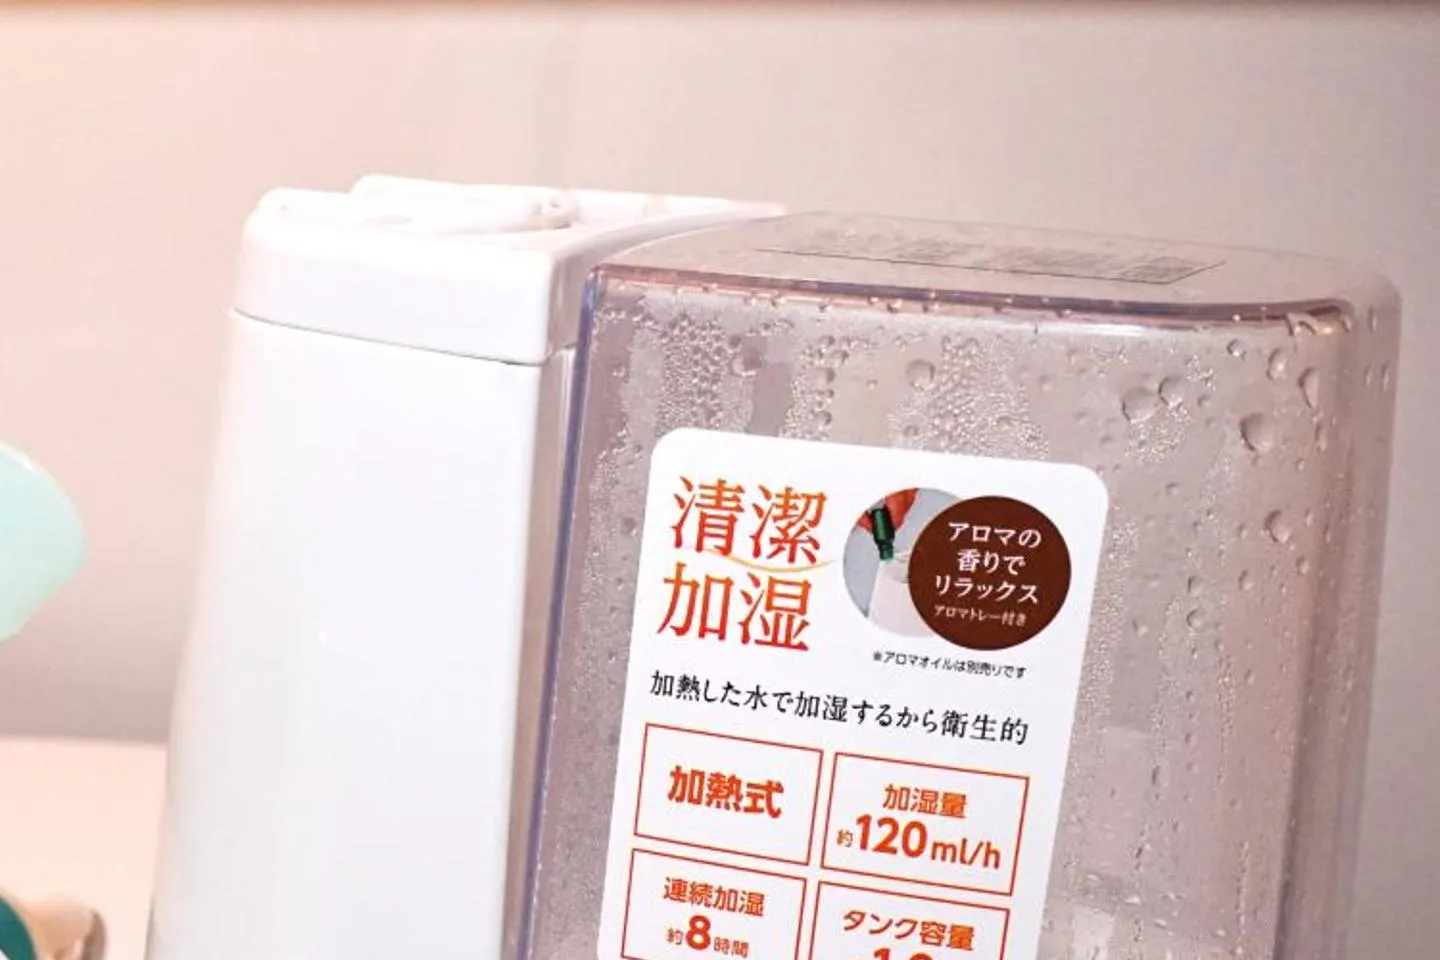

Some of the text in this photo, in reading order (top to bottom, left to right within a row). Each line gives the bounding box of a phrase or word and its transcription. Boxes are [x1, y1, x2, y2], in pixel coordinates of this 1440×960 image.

[671, 475, 826, 564] 清潔
[947, 521, 1042, 549] アロマの
[957, 550, 1026, 577] 香りで
[657, 562, 810, 651] 加湿
[934, 574, 1039, 604] リラックス
[933, 604, 1027, 627] アロマトレー付き
[649, 669, 1030, 746] 加熱した水で加湿するから衛生的
[667, 765, 785, 819] 加熱式
[882, 783, 968, 820] 加湿量
[663, 876, 765, 917] 連続加湿
[841, 910, 975, 952] タンク容量
